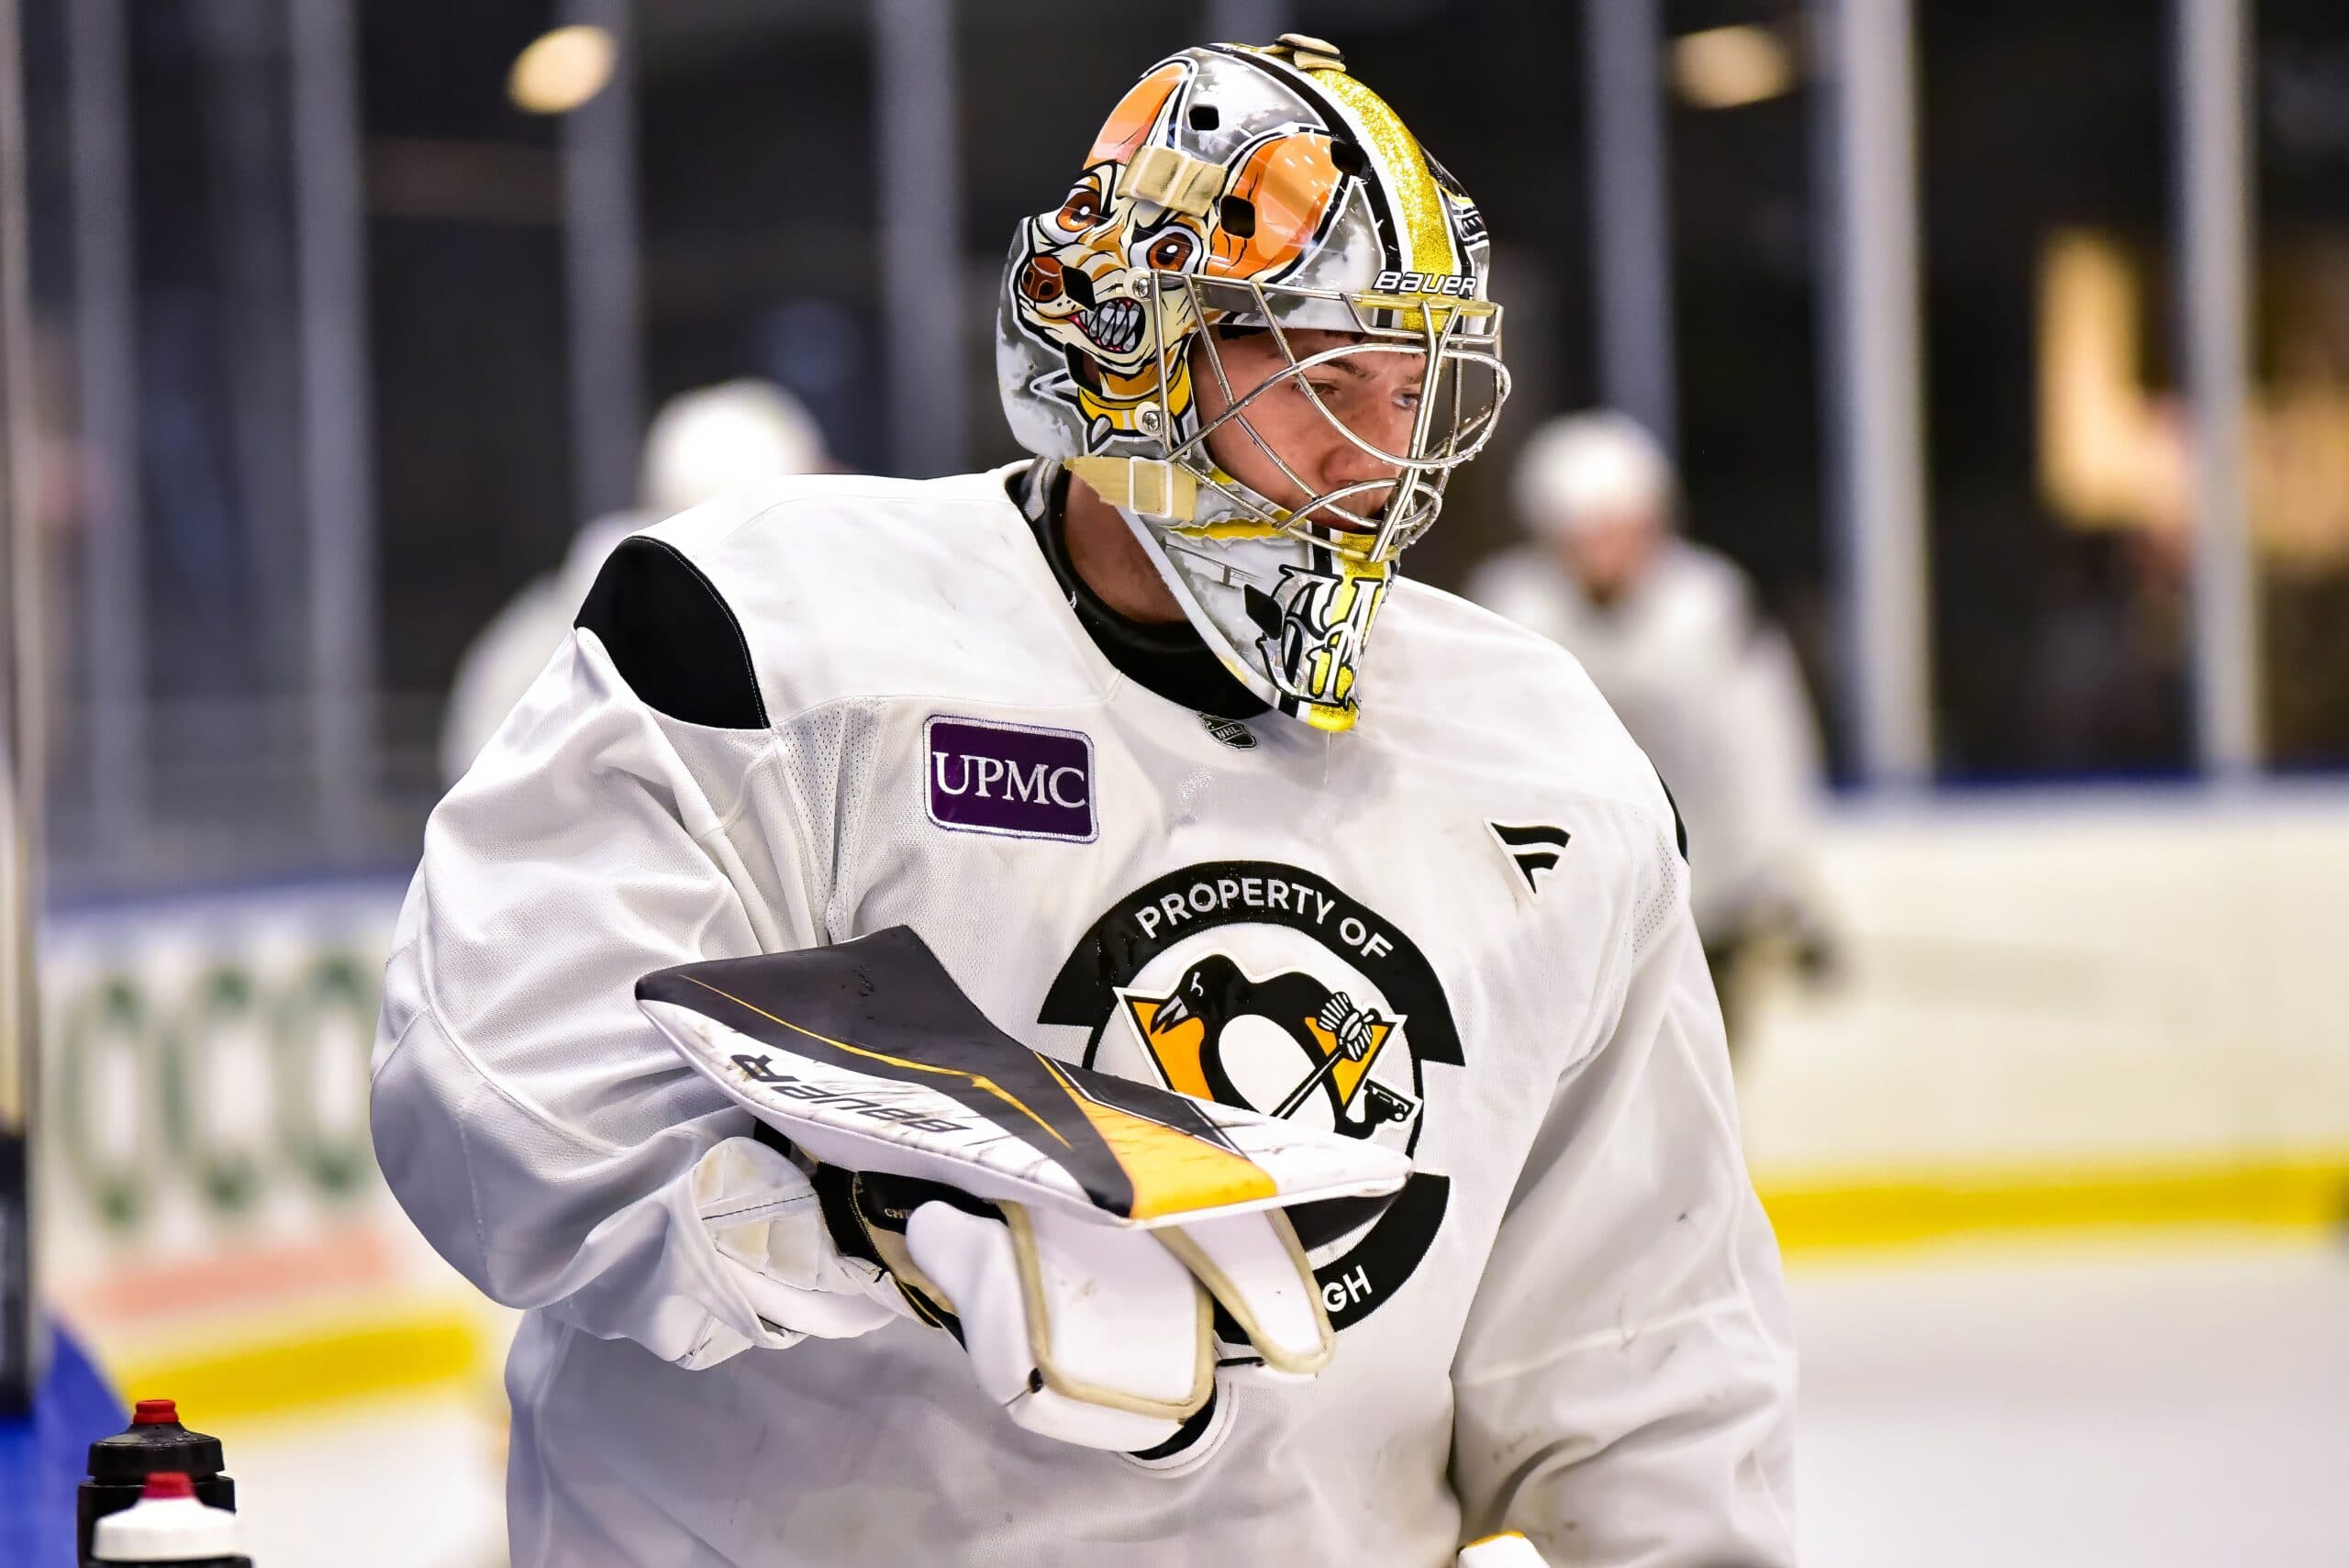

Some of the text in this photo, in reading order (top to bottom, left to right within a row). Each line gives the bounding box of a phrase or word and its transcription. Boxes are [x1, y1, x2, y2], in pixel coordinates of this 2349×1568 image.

[1372, 270, 1477, 295] BAUER
[1215, 726, 1241, 740] NHL
[932, 751, 1086, 808] UPMC
[1135, 877, 1394, 958] PROPERTY OF
[730, 1054, 973, 1132] BAUER
